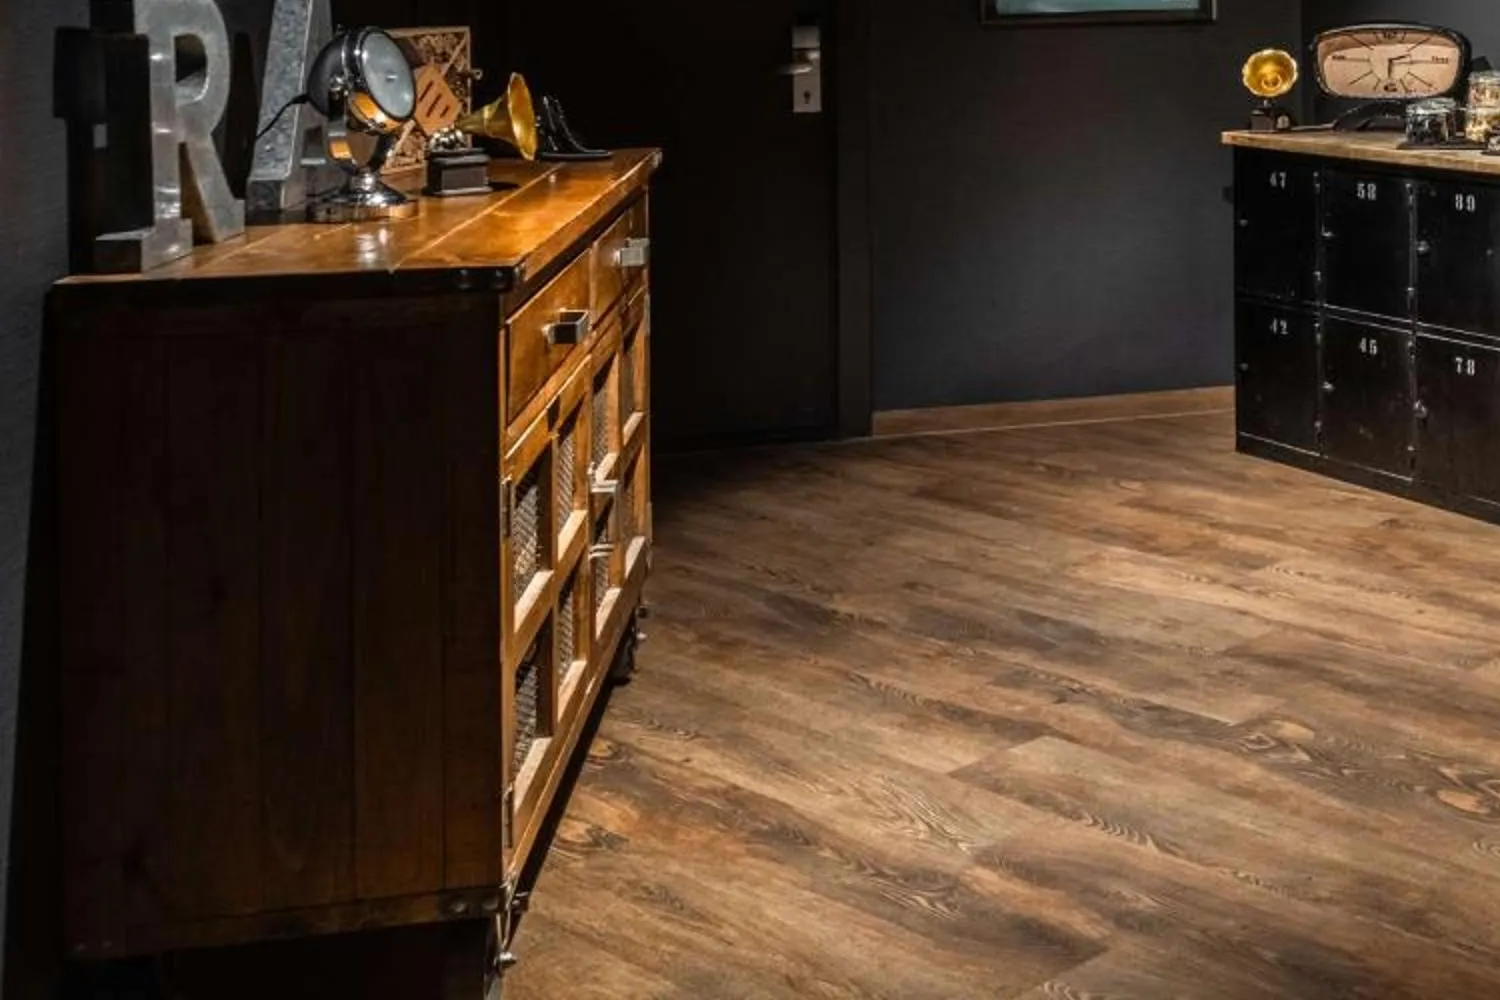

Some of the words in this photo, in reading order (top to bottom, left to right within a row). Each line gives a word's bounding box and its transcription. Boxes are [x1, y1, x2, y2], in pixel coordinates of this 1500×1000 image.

[1269, 171, 1287, 189] 47
[1356, 182, 1377, 201] 58
[1359, 337, 1378, 356] 45
[1455, 356, 1476, 376] 78
